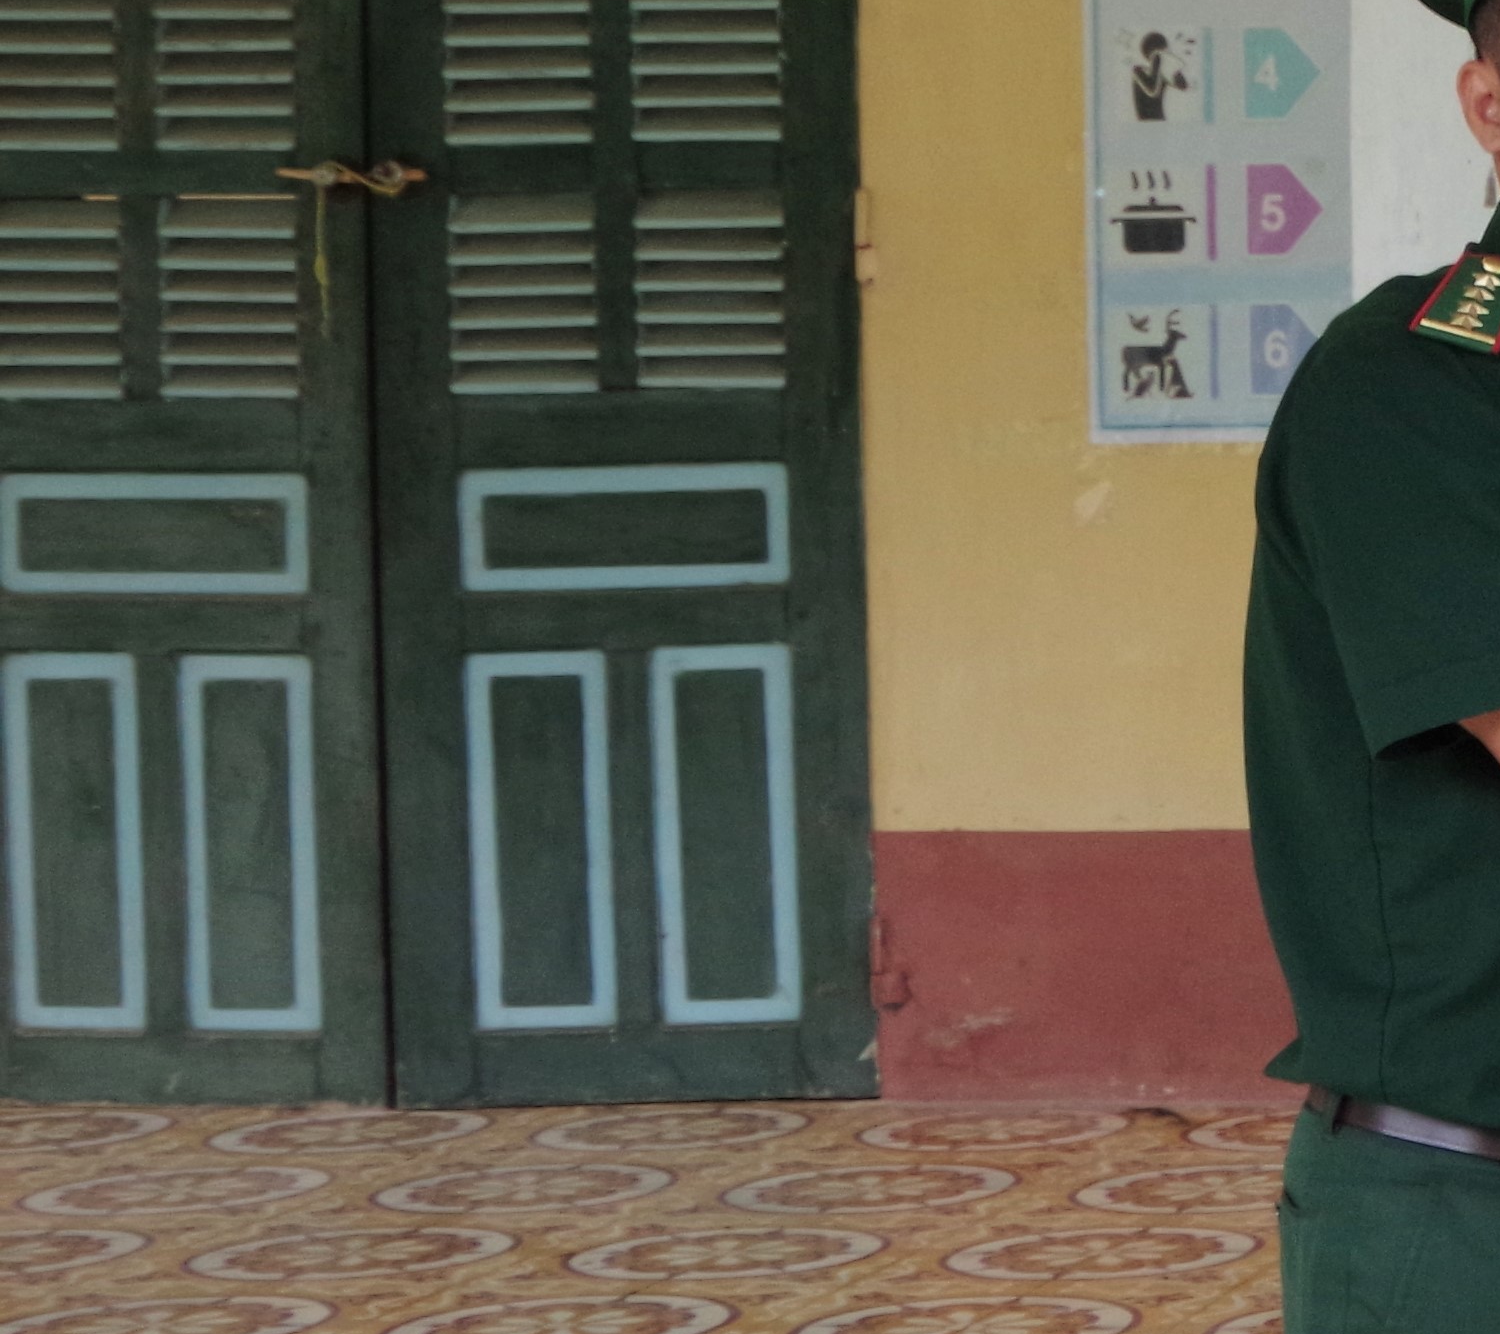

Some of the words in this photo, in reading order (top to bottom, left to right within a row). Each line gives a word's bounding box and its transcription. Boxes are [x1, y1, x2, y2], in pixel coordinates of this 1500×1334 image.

[1254, 54, 1279, 91] 4
[1261, 193, 1286, 233] 5
[1264, 329, 1289, 368] 6
